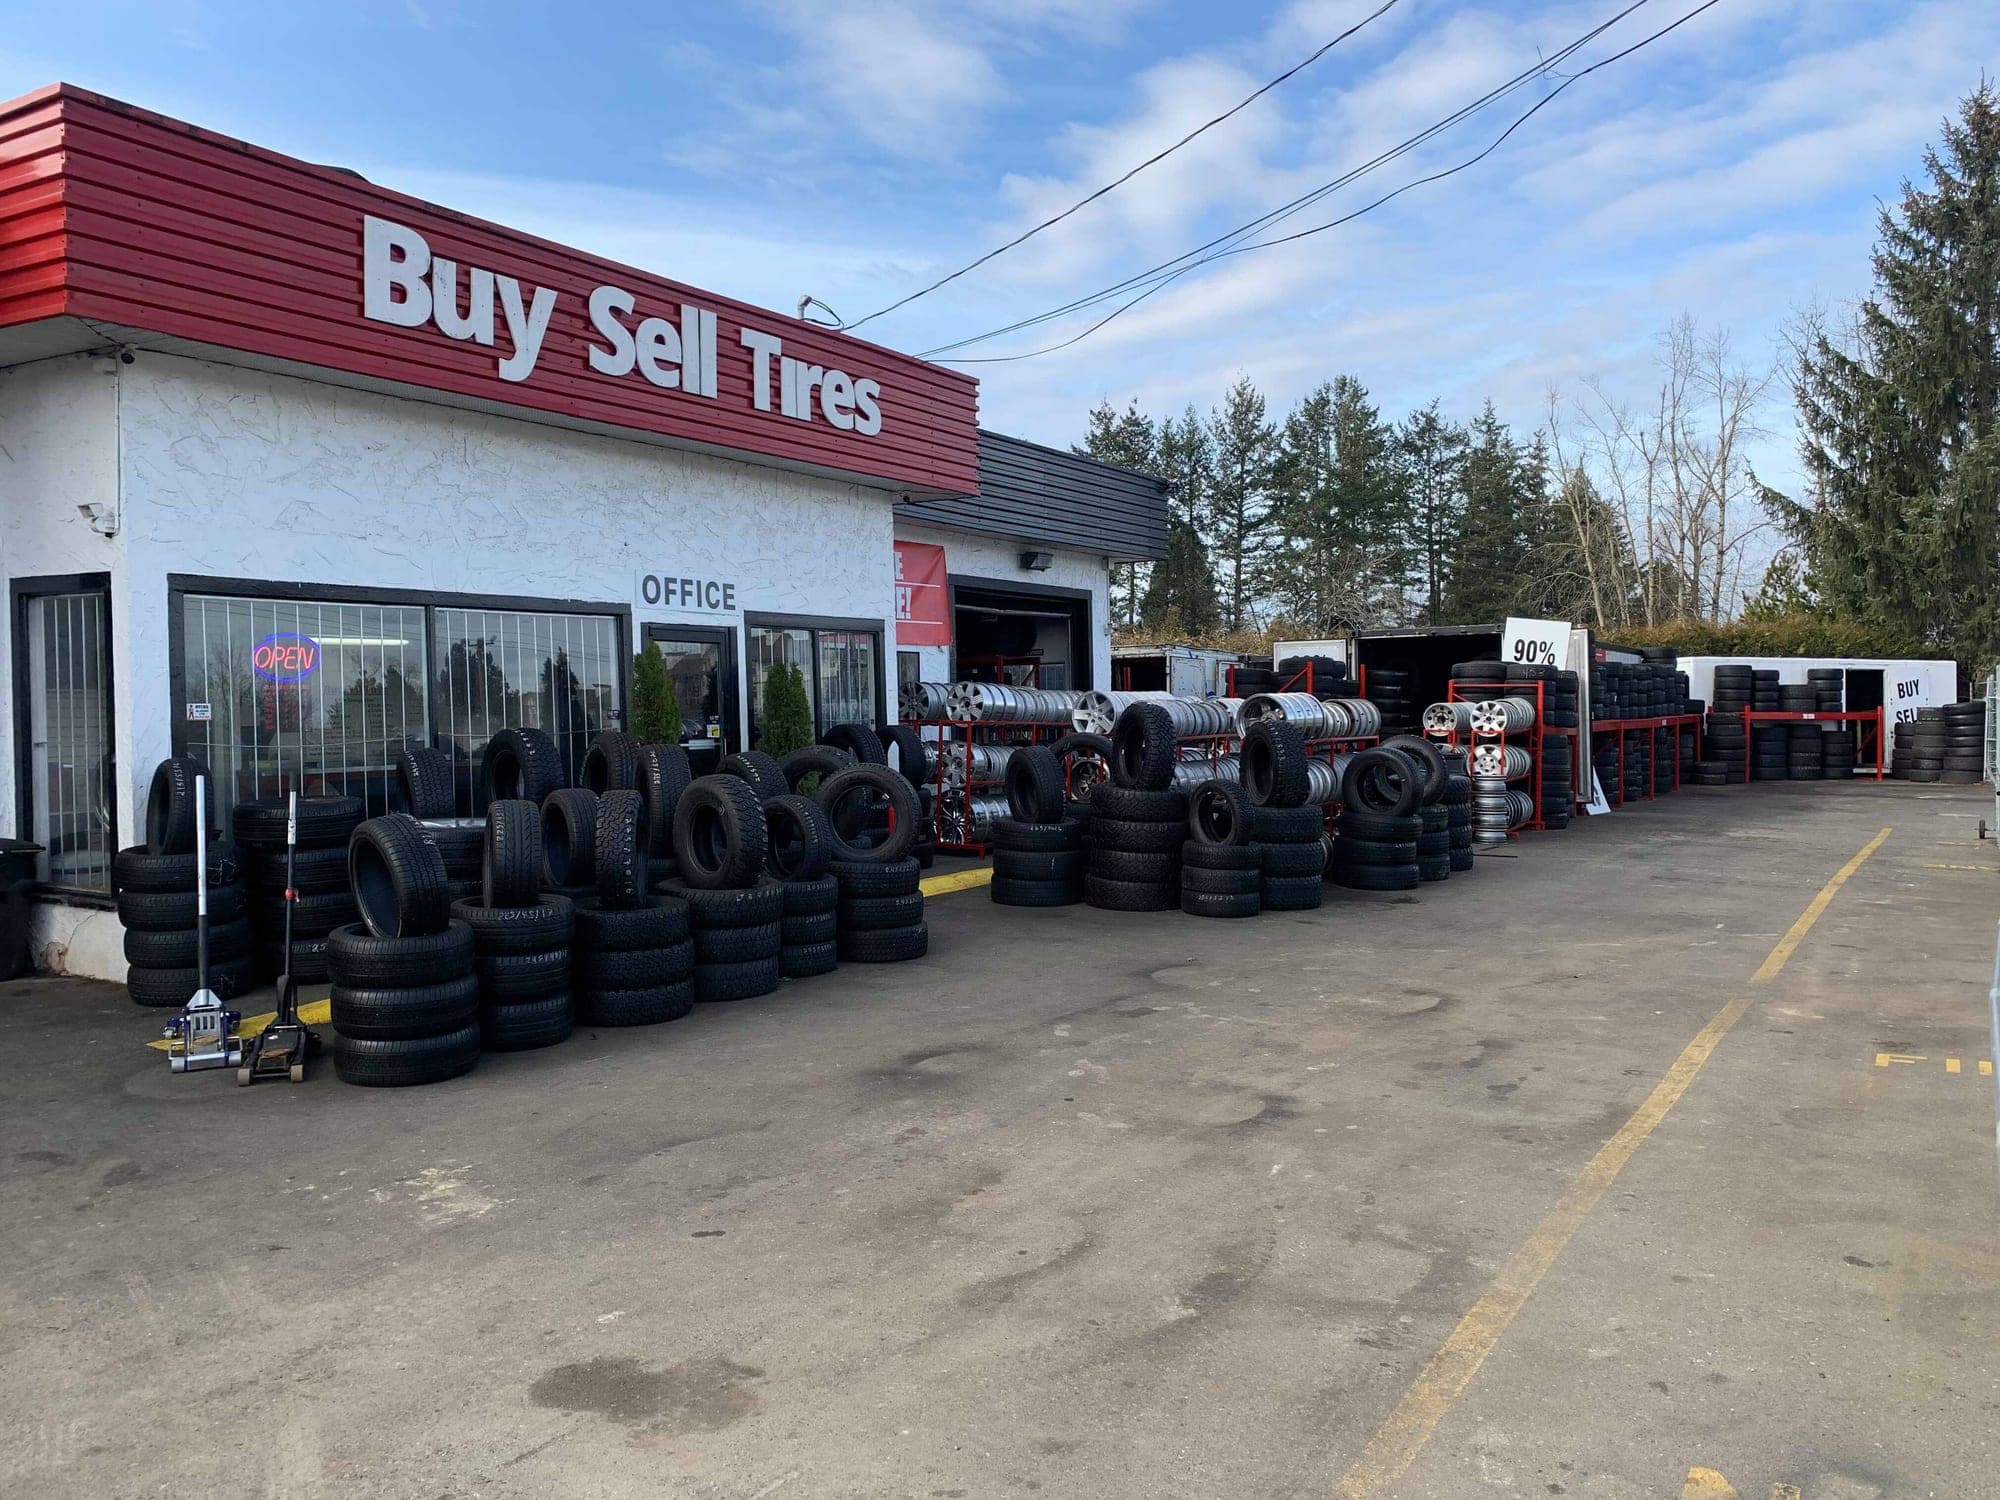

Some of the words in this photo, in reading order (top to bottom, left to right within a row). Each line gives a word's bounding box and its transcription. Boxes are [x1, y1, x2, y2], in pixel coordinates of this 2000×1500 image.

[363, 214, 558, 382] Buy
[588, 285, 718, 399] Sell
[740, 327, 882, 437] Tires
[642, 574, 736, 611] OFFICE
[254, 646, 315, 670] OPEN
[1513, 638, 1556, 665] 90%
[1897, 678, 1920, 699] BUY
